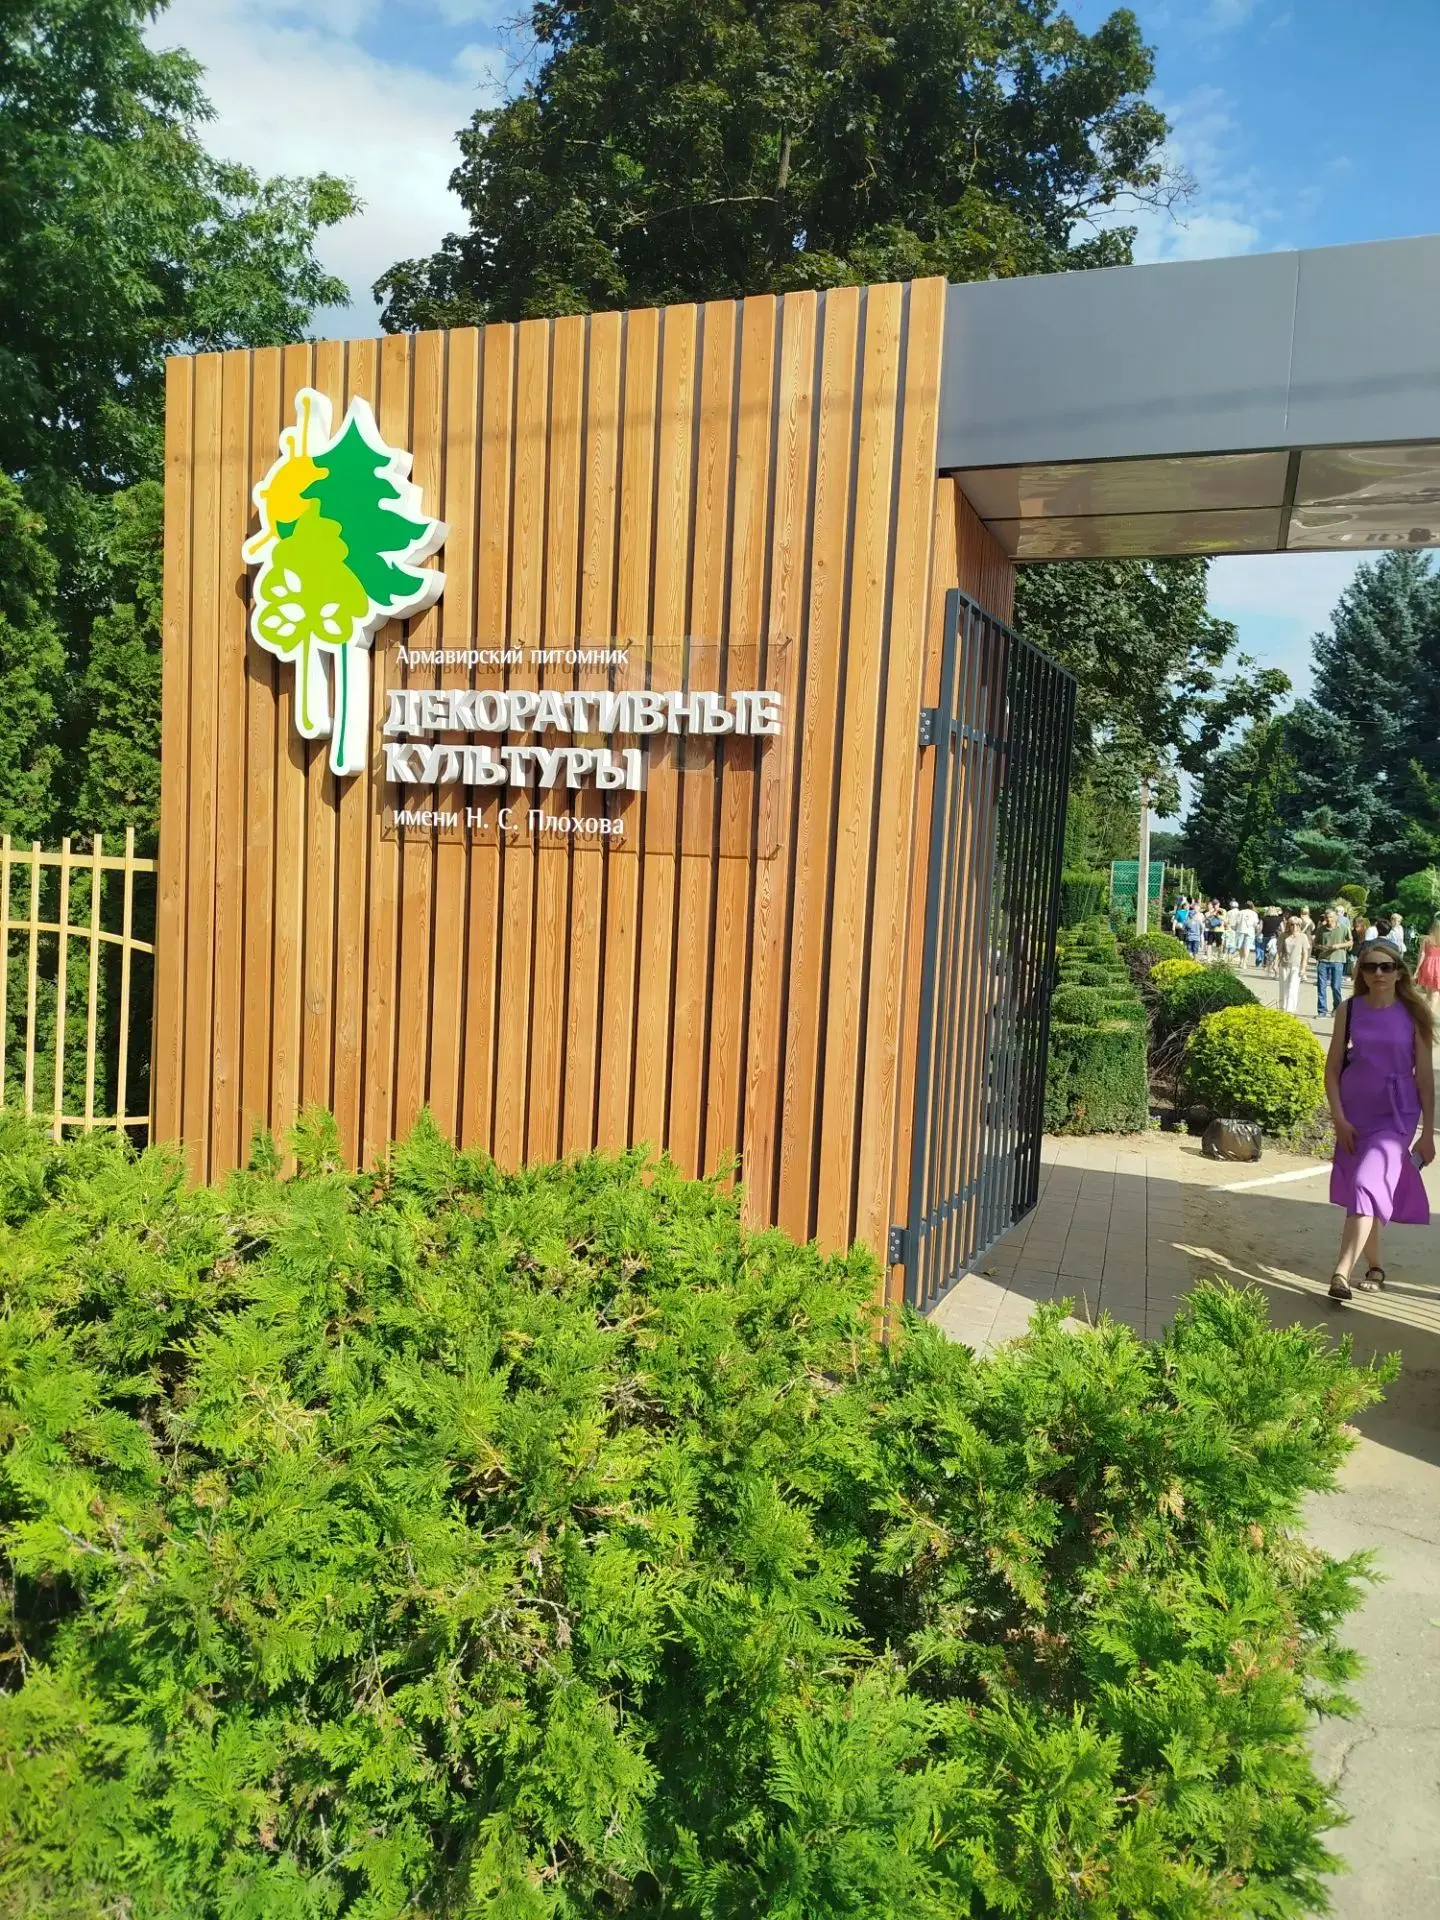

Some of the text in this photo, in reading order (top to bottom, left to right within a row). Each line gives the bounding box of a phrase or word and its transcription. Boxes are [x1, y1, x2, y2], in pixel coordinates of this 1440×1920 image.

[395, 645, 629, 670] Армавирский питомник
[382, 688, 782, 736] ДЕКОРАТИВНЫЕ
[382, 742, 648, 791] КУЛЬТУРЫ
[393, 806, 624, 834] имени Н. С. Плохова
